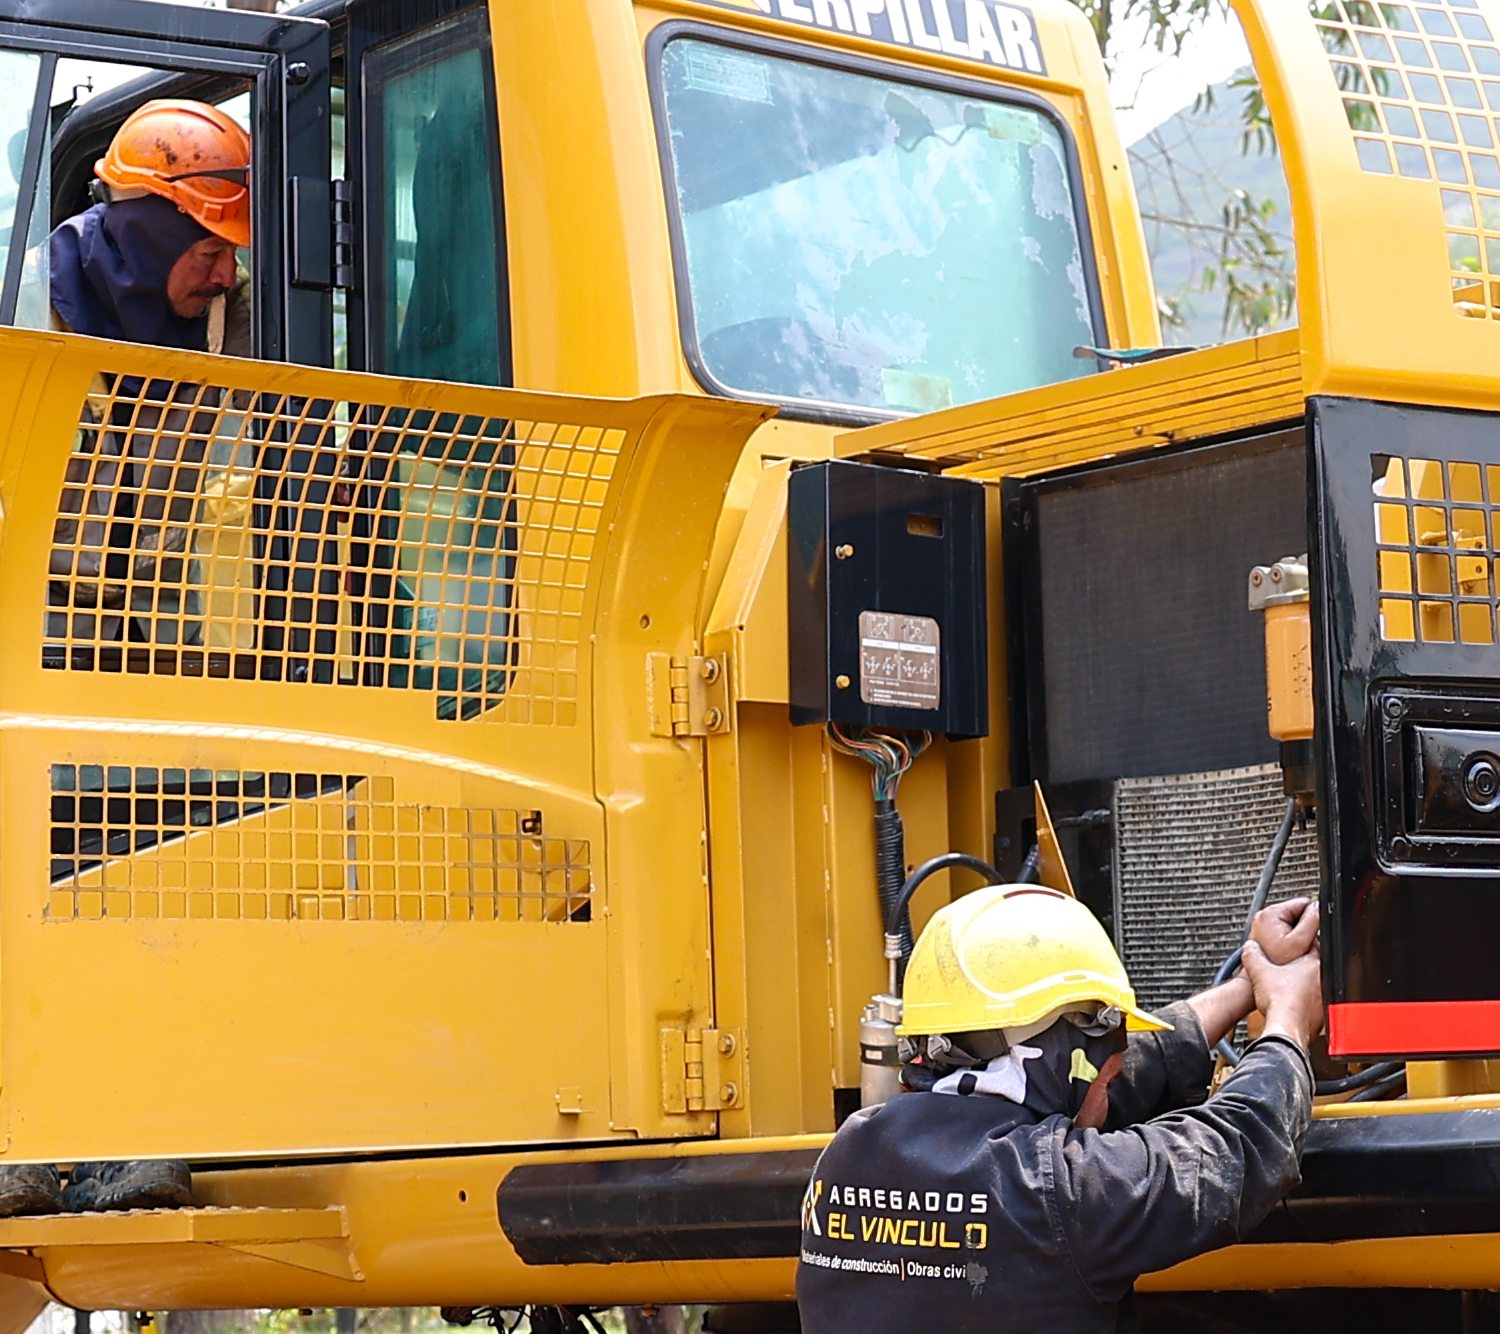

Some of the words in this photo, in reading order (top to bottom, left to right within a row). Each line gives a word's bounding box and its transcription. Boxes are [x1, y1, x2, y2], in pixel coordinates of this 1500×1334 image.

[829, 1185, 988, 1214] AGREGADOS
[827, 1212, 855, 1240] EL
[861, 1215, 987, 1250] VINCULO
[831, 1255, 841, 1269] de
[841, 1258, 900, 1275] construcción
[907, 1261, 941, 1278] Obras
